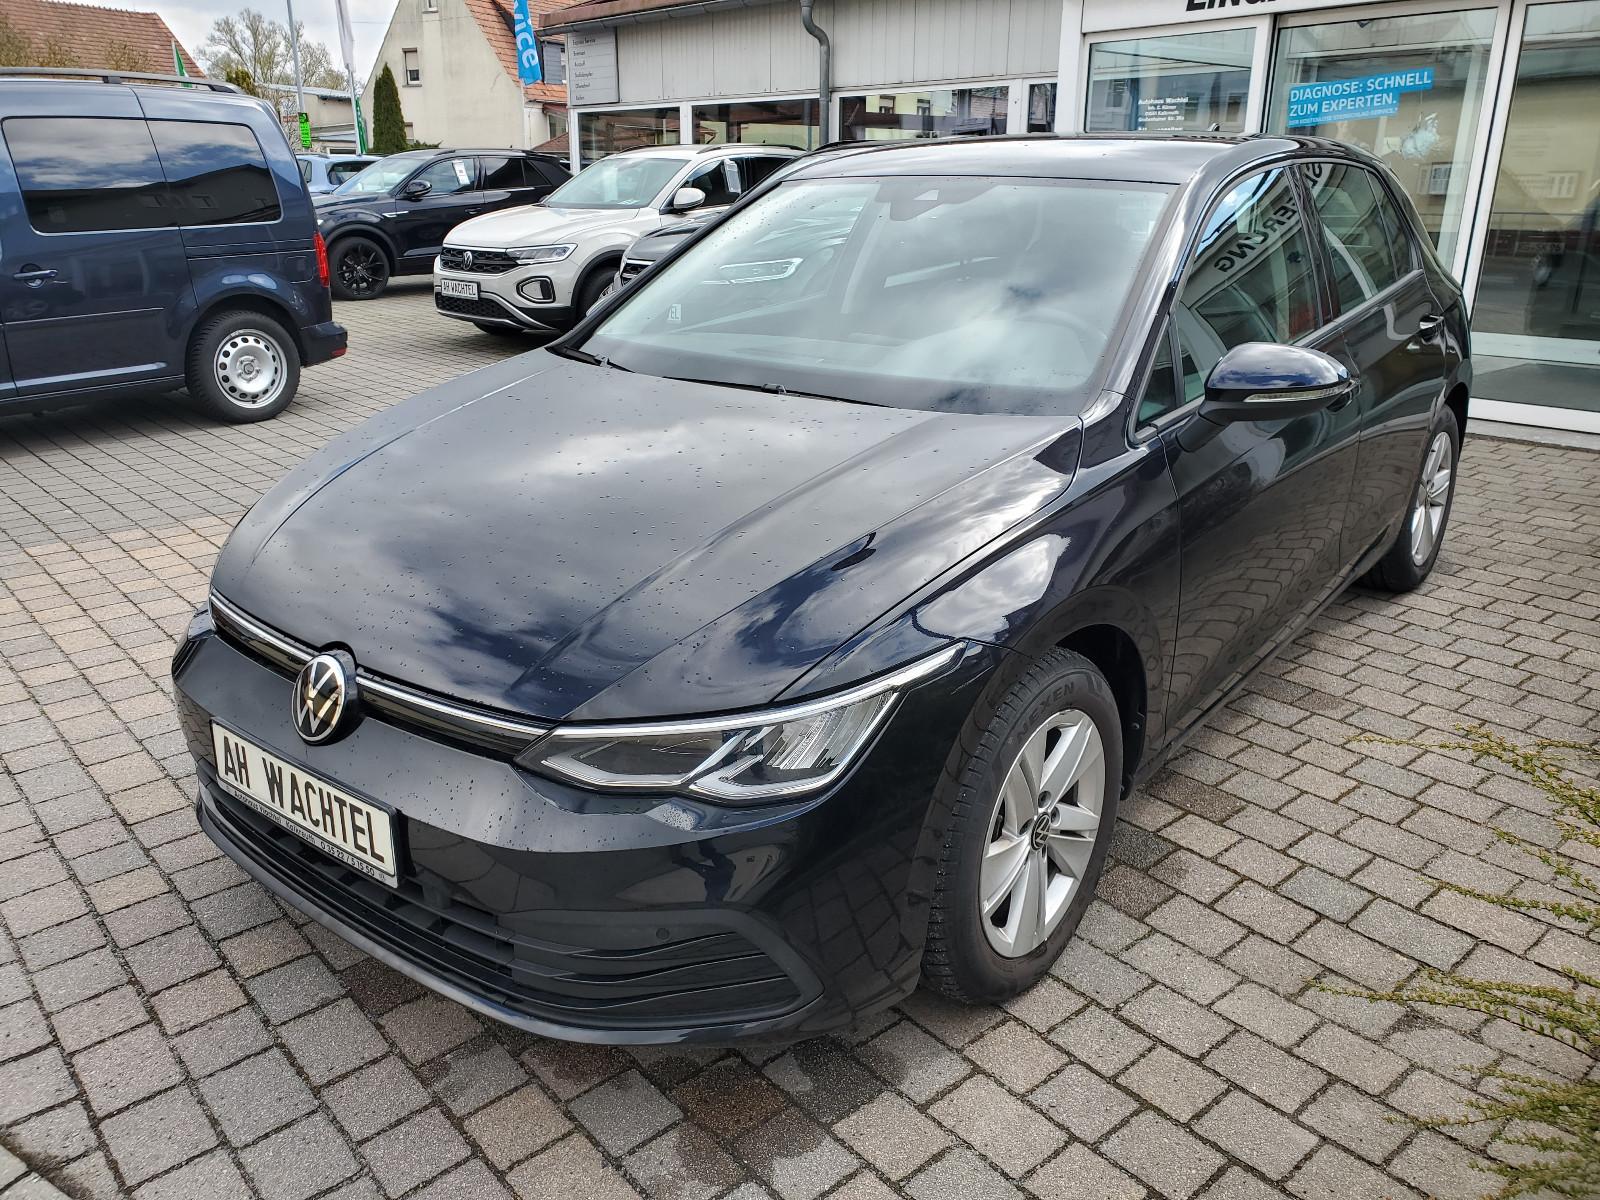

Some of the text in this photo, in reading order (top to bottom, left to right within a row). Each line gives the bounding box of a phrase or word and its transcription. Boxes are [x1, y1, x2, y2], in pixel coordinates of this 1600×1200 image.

[1290, 71, 1432, 102] DIAGNOSE: SCHNELL
[1289, 92, 1397, 117] ZUM EXPERTEN.
[450, 281, 476, 296] WACHTEL
[223, 735, 385, 864] AH WACHTEL
